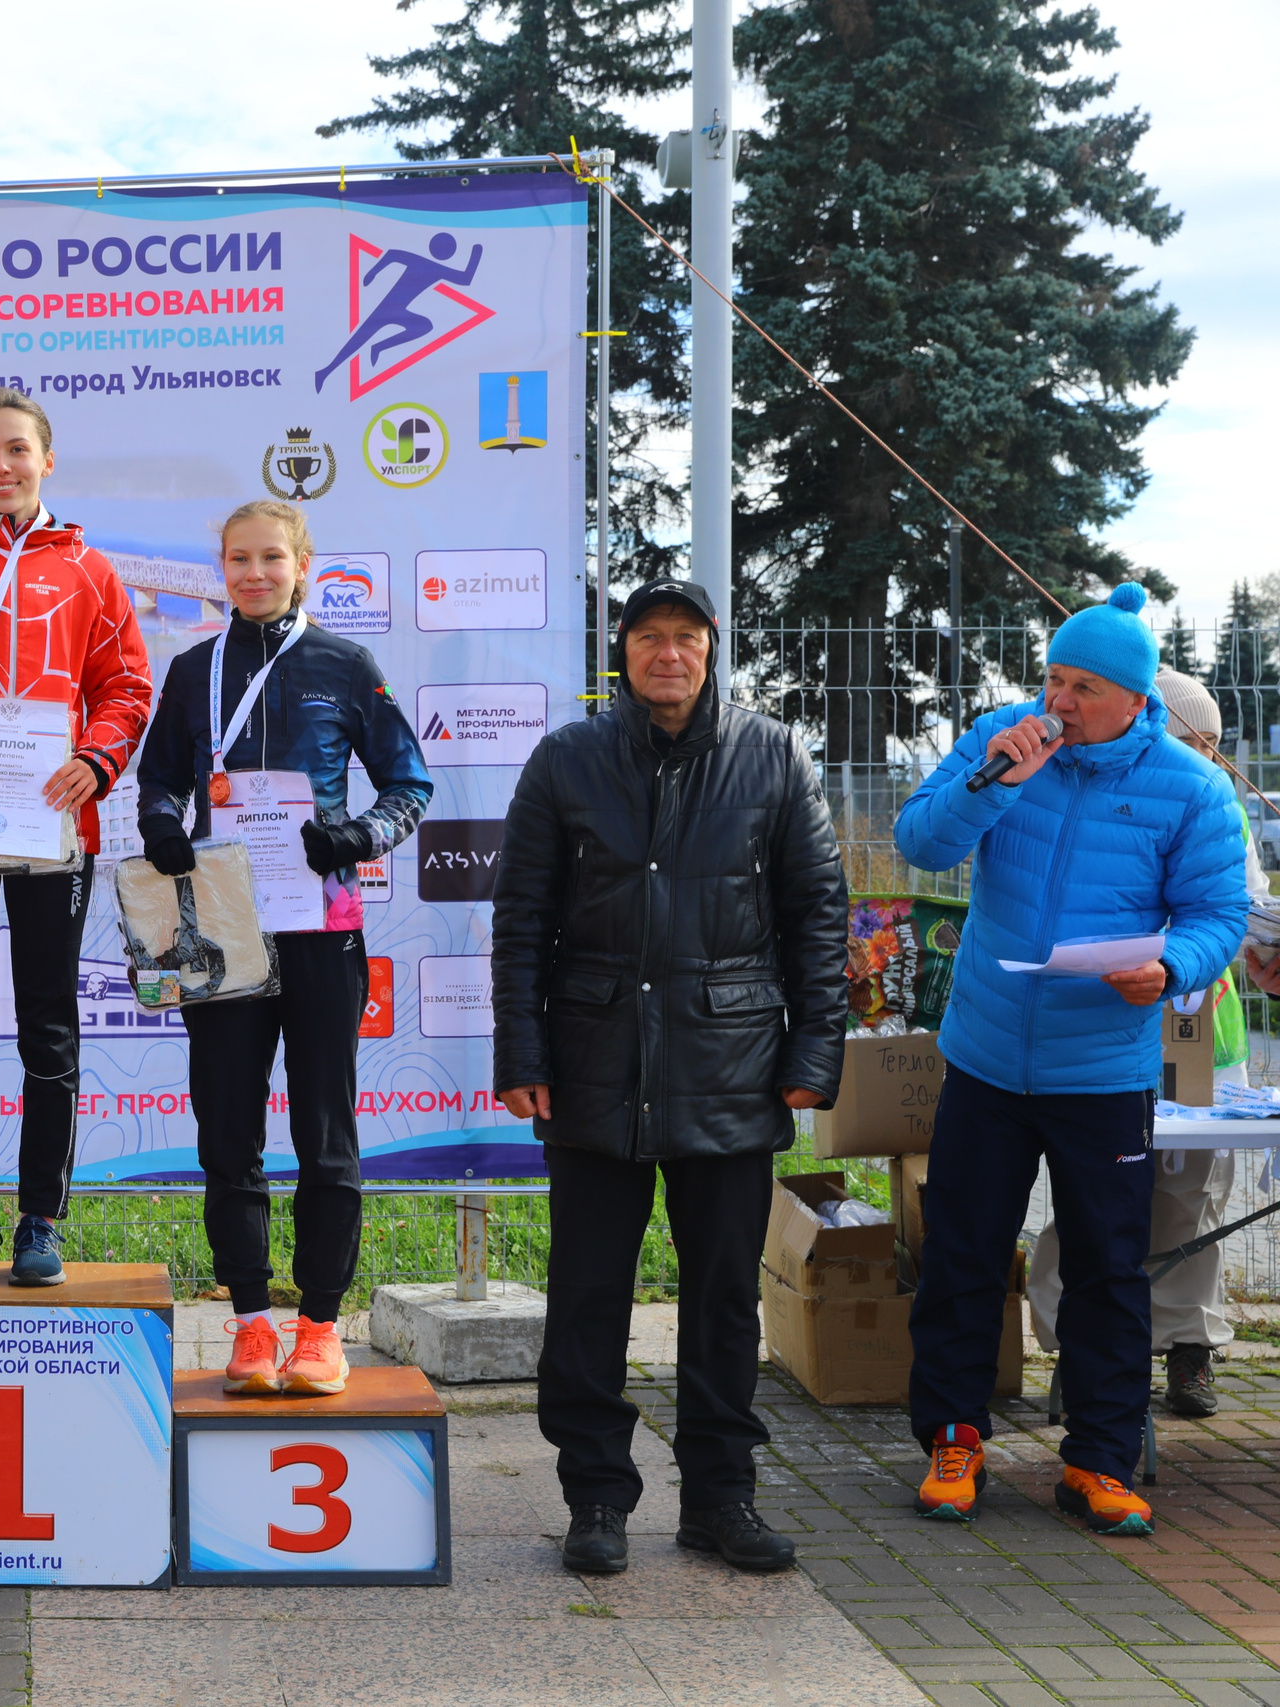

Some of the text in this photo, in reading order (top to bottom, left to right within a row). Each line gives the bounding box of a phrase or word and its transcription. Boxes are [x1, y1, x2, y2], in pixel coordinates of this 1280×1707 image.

[57, 232, 282, 277] РОССИИ
[39, 325, 284, 352] ОРИЕНТИРОВАНИЯ
[40, 373, 125, 399] город
[131, 365, 282, 390] Ульяновск
[279, 446, 320, 455] ТРИУМФ
[381, 465, 431, 475] УЛСПОРТ
[25, 583, 60, 592] ORIENTEERING
[454, 572, 540, 593] azimut
[308, 610, 388, 620] ОНД ПОДДЕРЖКИ
[456, 709, 516, 717] МЕТАЛЛО
[457, 718, 544, 728] ПРОФИЛЬНЫЙ
[457, 732, 497, 740] ЗАВОД
[236, 812, 289, 825] ДИПЛОМ
[251, 825, 281, 833] степень
[355, 1091, 462, 1116] ДУХОМ
[34, 1360, 120, 1375] ОБЛАСТИ
[268, 1442, 352, 1554] 3
